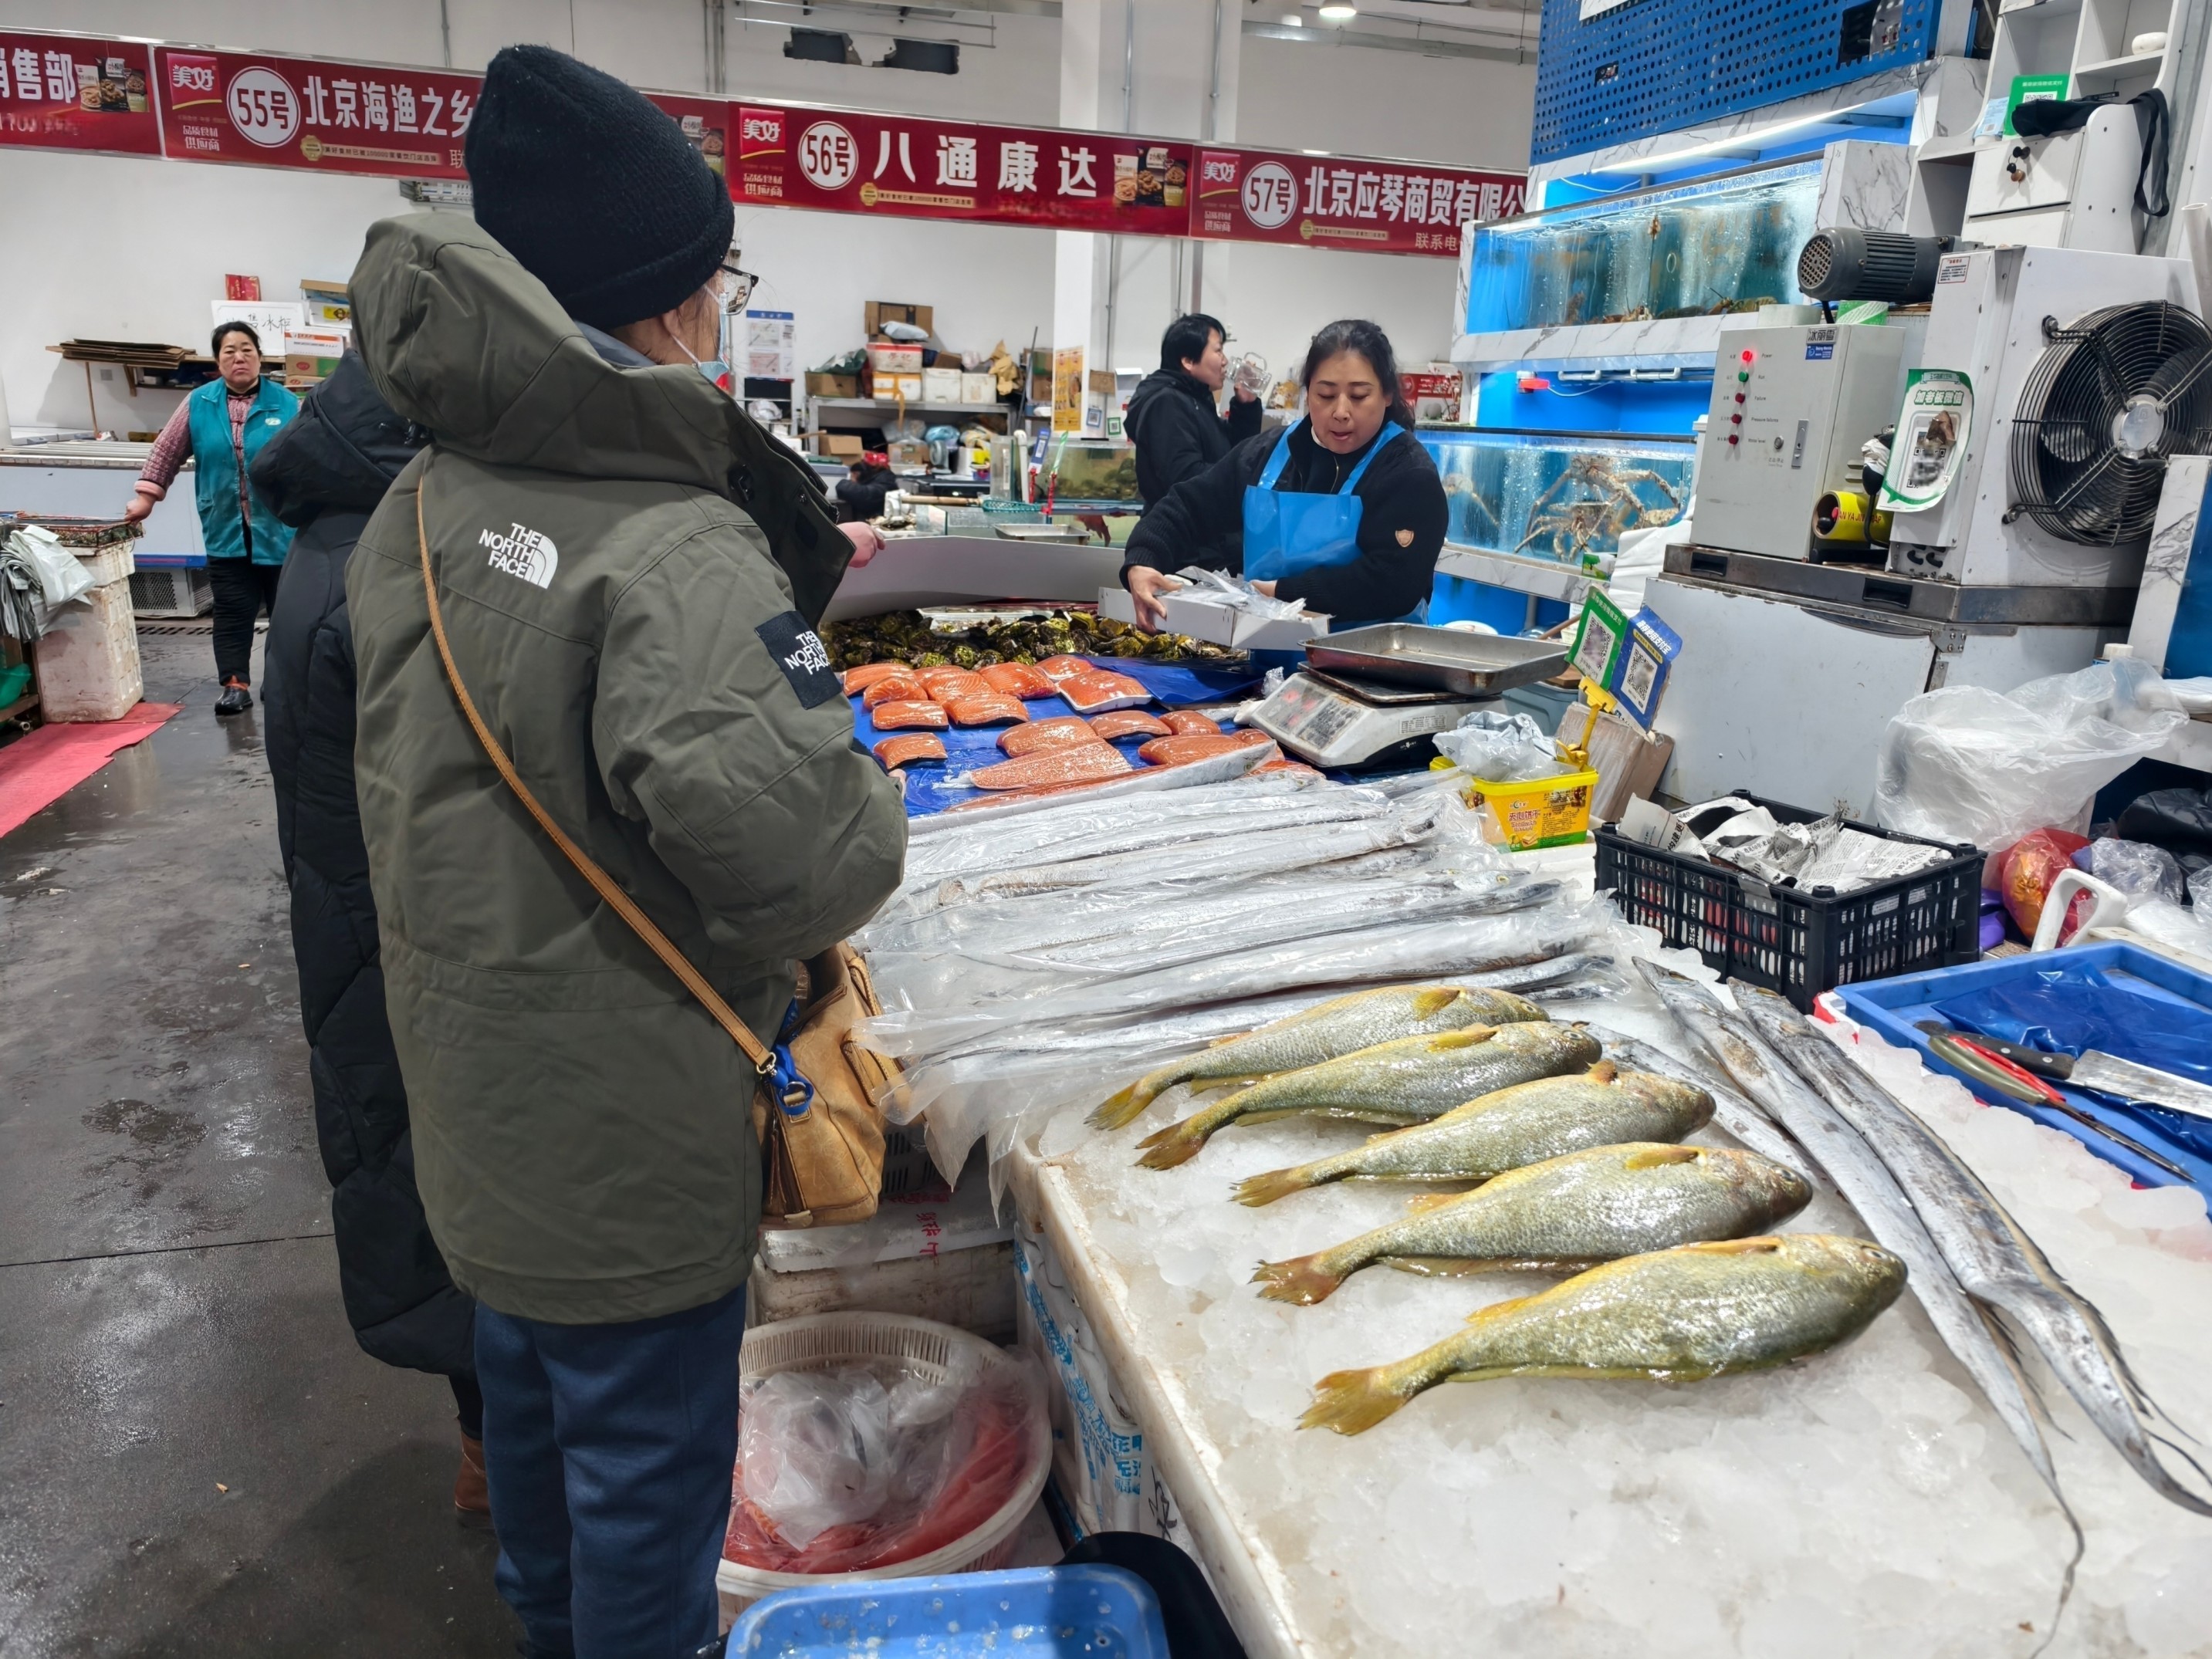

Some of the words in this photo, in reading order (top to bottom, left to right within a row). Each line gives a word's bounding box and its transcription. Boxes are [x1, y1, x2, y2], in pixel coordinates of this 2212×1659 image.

[173, 65, 215, 91] 美好
[236, 87, 289, 130] 55号
[303, 75, 474, 138] 北京海渔之乡
[184, 136, 220, 151] 供应商
[742, 118, 781, 142] 美好
[807, 134, 851, 178] 56号
[873, 130, 1097, 198] 八通康达
[1202, 160, 1236, 182] 美好
[1249, 177, 1291, 215] 57号
[1302, 165, 1527, 228] 北京应琴商贸有限公
[1415, 231, 1461, 252] 联系电
[226, 313, 292, 335] 售冰柜
[1914, 390, 1964, 406] 加老板微信
[479, 529, 536, 564] NORTH
[511, 522, 543, 549] THE
[488, 549, 529, 579] FACE
